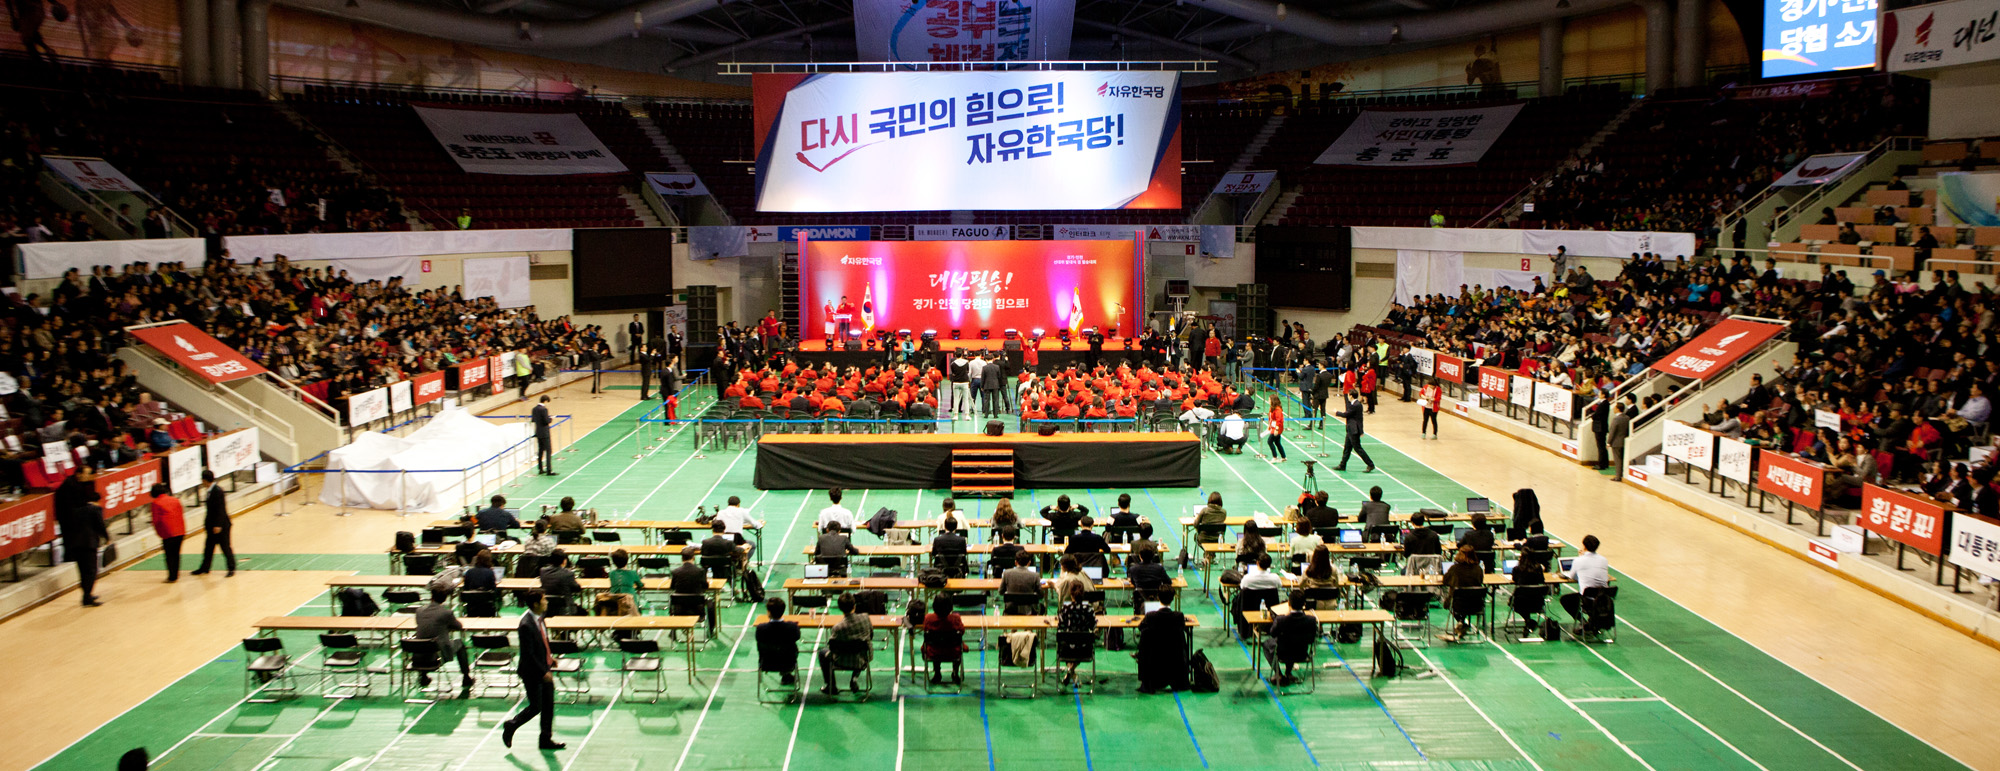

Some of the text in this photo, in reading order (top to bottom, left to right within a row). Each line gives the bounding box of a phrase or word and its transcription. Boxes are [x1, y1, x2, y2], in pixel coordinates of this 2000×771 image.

[1780, 23, 1827, 56] 당협
[1109, 85, 1164, 98] 자유한국당
[801, 81, 1064, 151] 다시 국민의 힘으로!
[463, 134, 534, 145] 대한민국의
[967, 113, 1123, 165] 자유한국당!
[1377, 127, 1474, 141] 서민대통령
[446, 144, 516, 160] 홍준표
[952, 228, 989, 237] FAGUO
[848, 257, 882, 265] 자유한국당
[929, 270, 1013, 295] 대선필승!
[961, 298, 992, 310] 당원의
[995, 298, 1029, 310] 힘으로!
[1670, 355, 1716, 372] 인천시당
[1767, 464, 1813, 496] 서민대통령
[1958, 530, 2000, 562] 대통령
